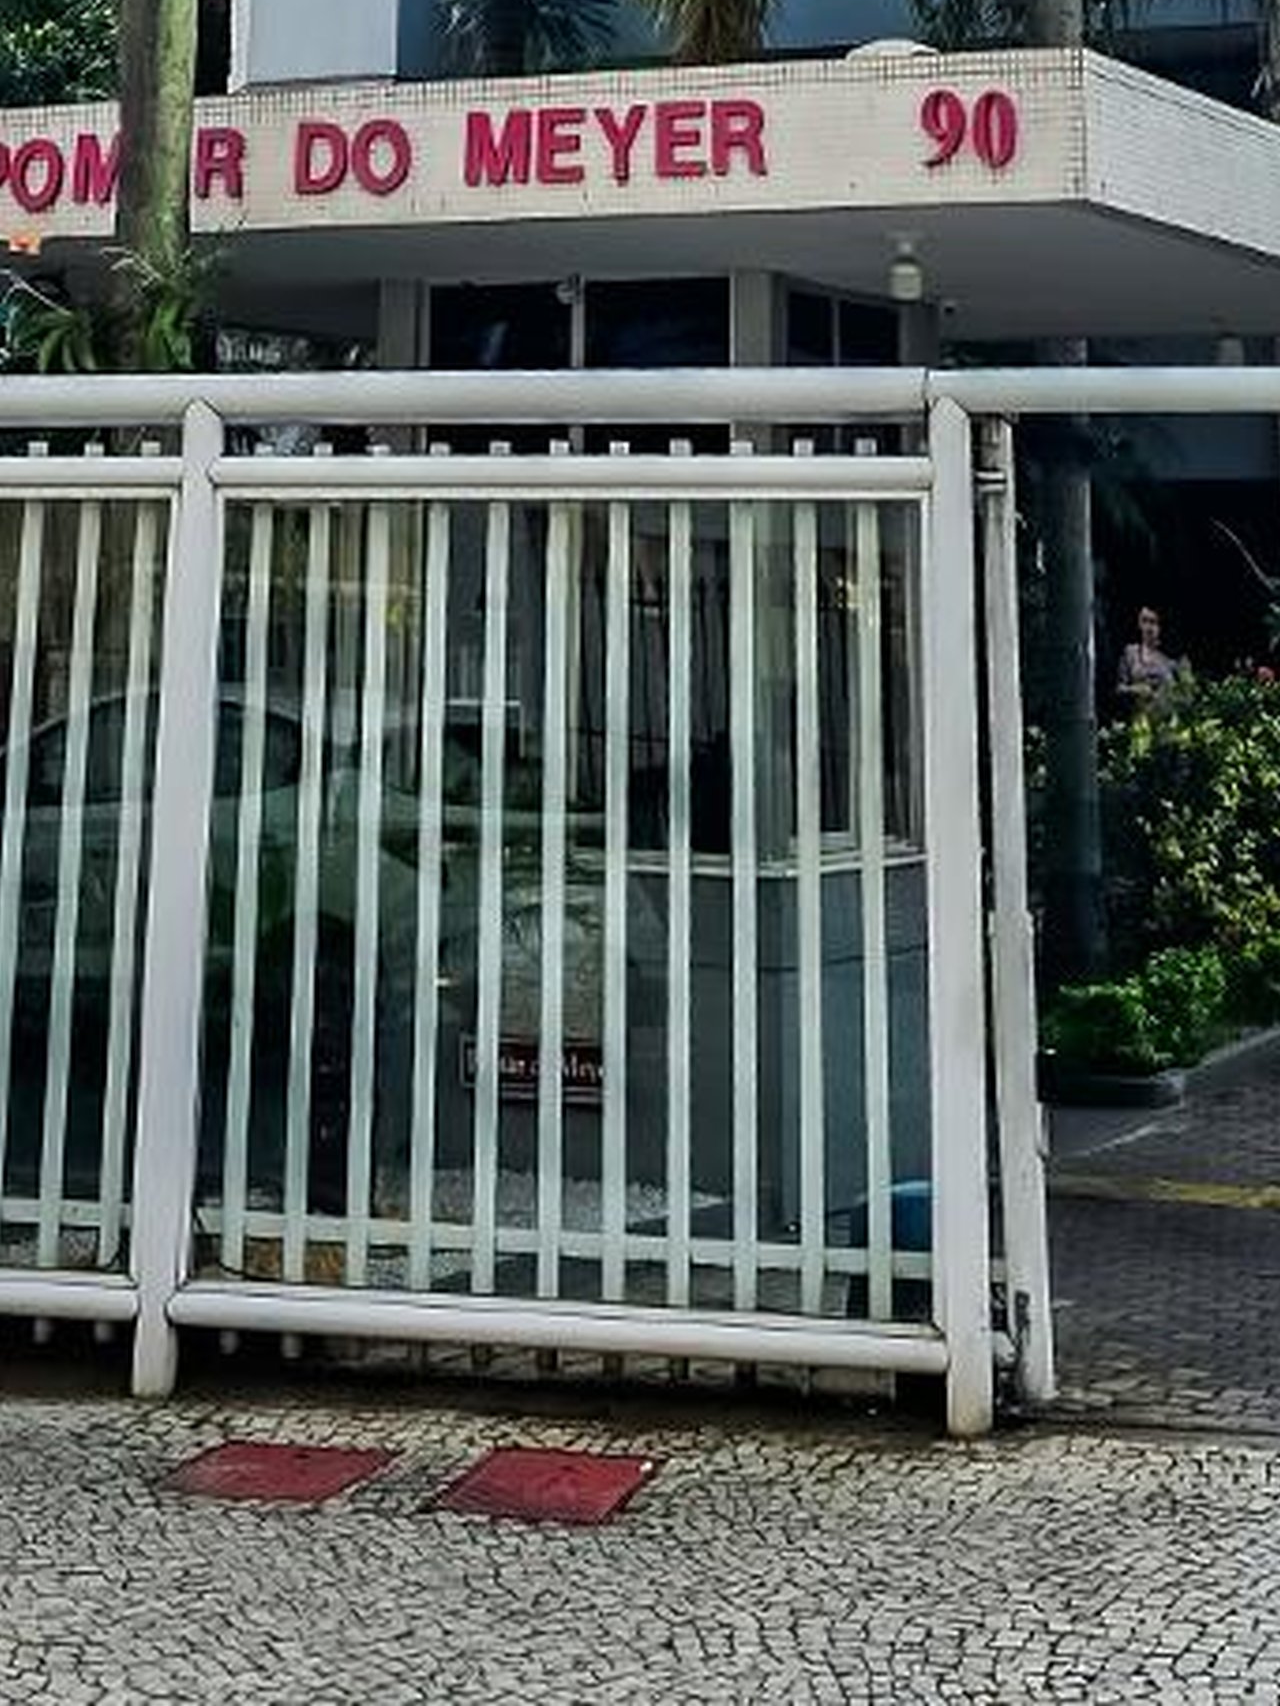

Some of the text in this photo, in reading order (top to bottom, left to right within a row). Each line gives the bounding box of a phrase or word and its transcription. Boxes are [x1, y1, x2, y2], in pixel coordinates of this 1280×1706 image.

[292, 119, 412, 196] DO
[464, 100, 768, 188] MEYER
[920, 89, 1017, 169] 90
